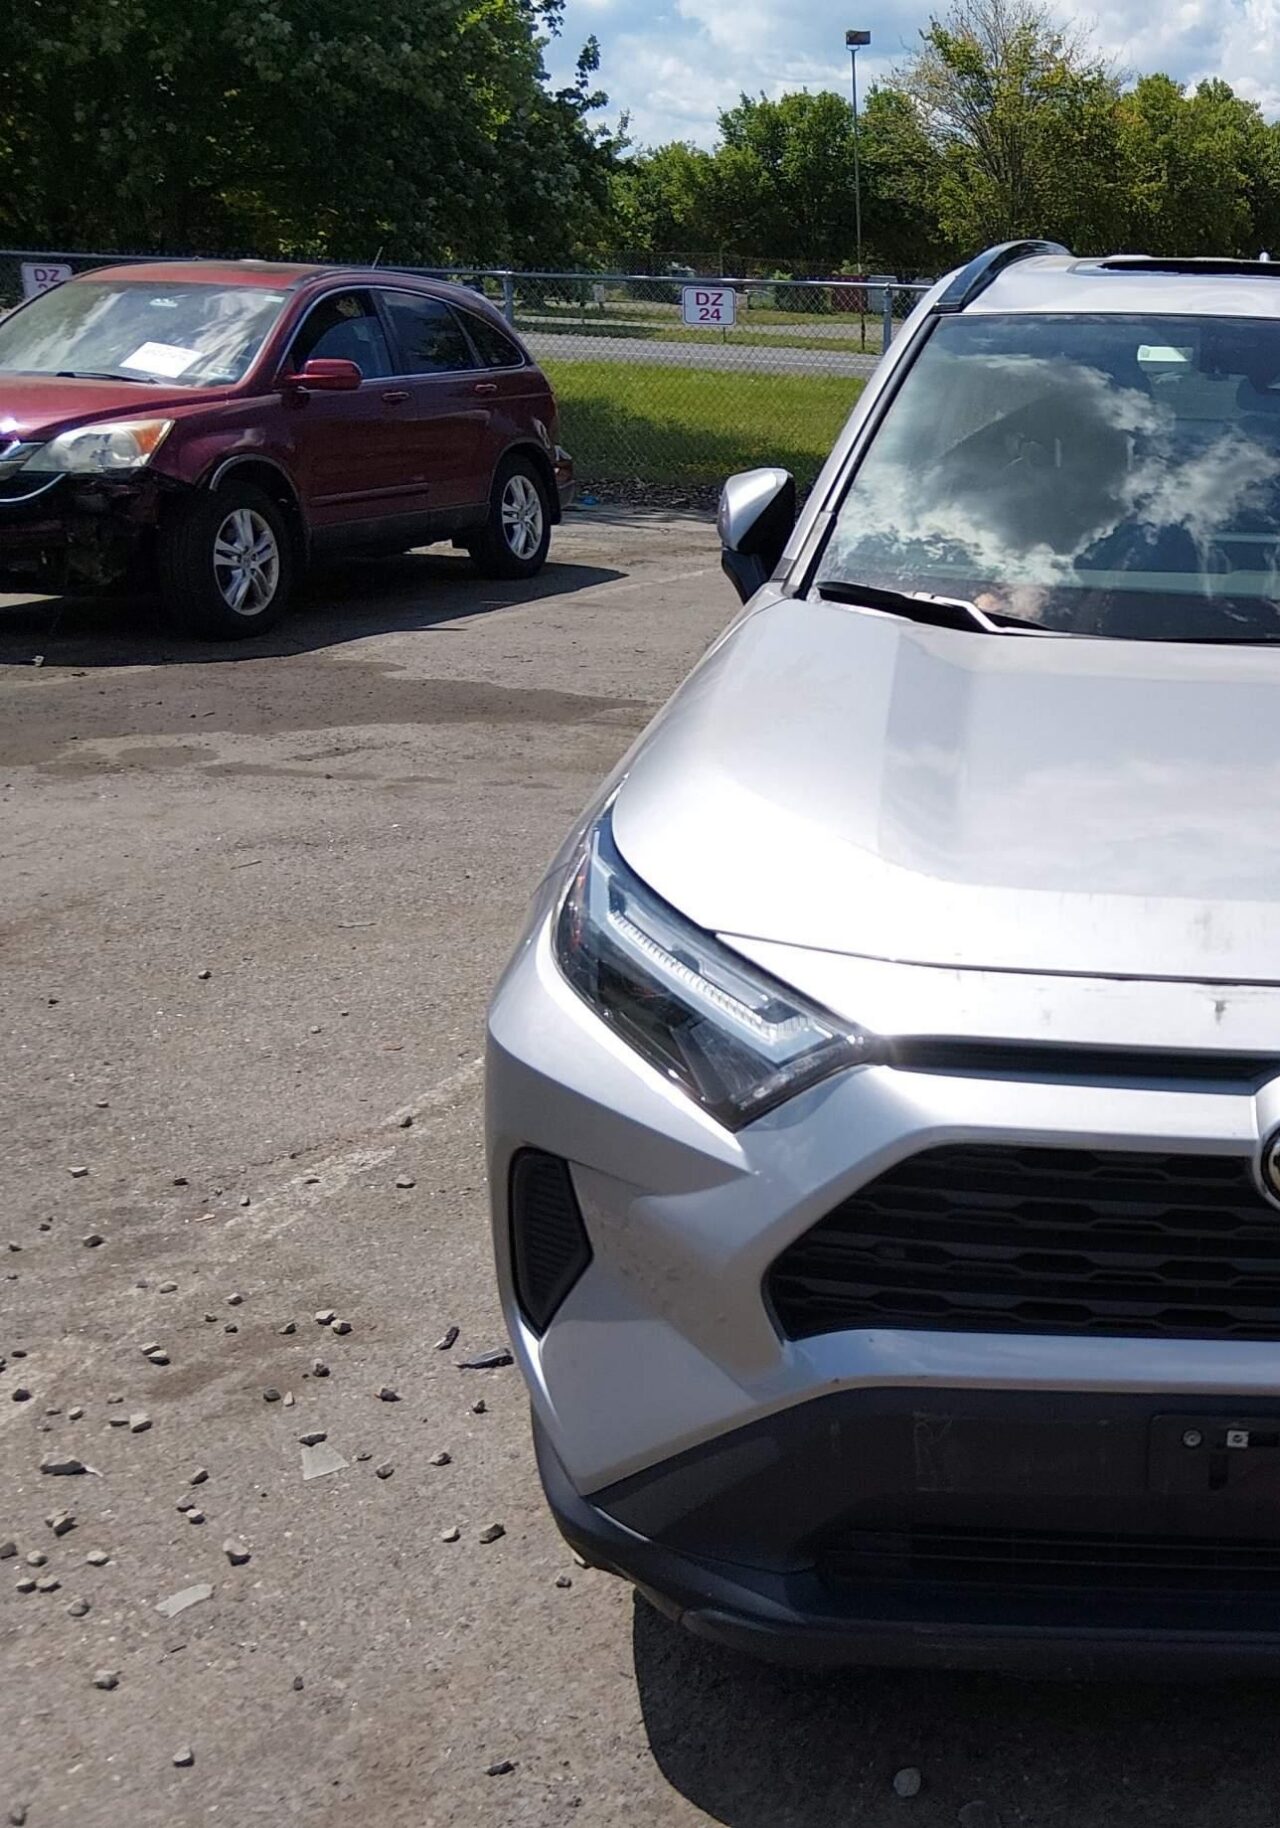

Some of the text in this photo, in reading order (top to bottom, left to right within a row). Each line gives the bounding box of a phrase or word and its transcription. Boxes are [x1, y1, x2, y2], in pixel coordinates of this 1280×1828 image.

[34, 268, 60, 282] DZ
[695, 292, 724, 306] DZ
[699, 307, 722, 321] 24
